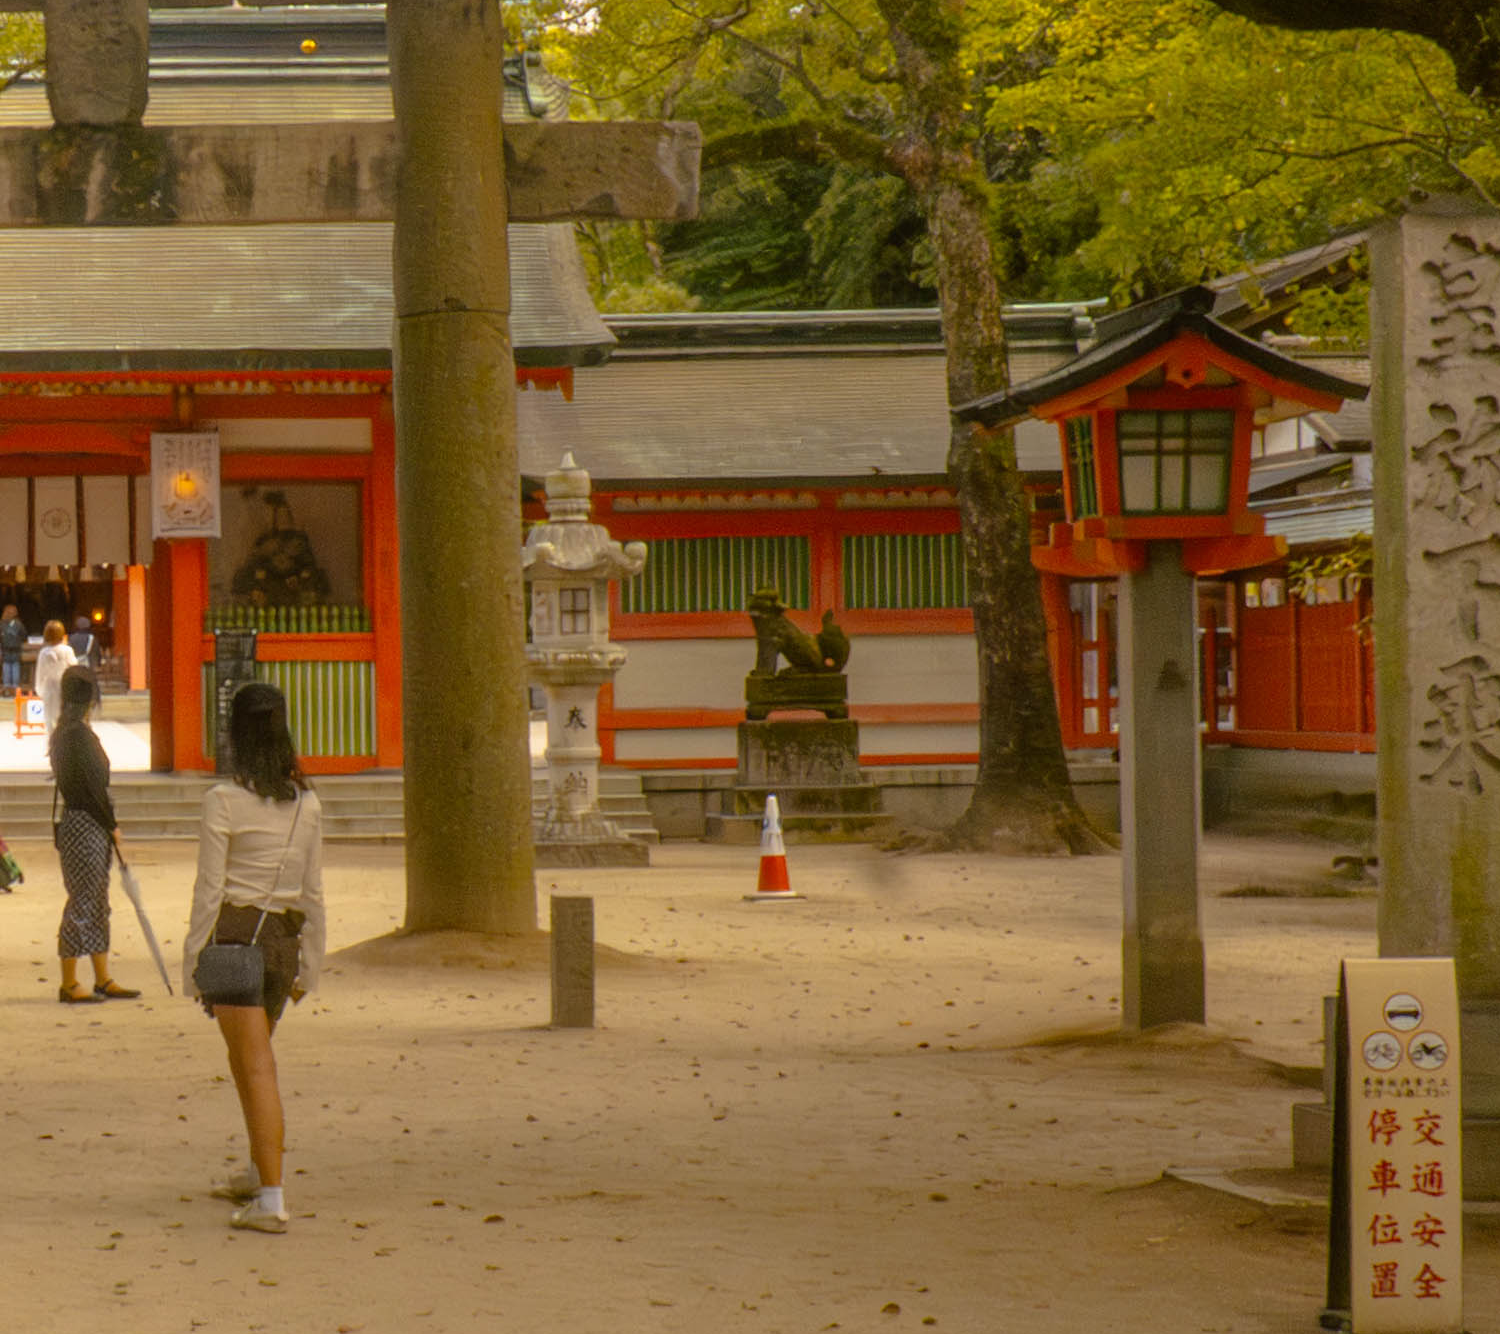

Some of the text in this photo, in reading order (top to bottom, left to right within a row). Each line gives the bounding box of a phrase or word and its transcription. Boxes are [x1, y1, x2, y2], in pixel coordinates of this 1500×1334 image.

[1366, 1109, 1402, 1300] 停車位置
[1410, 1109, 1446, 1300] 交通安全
